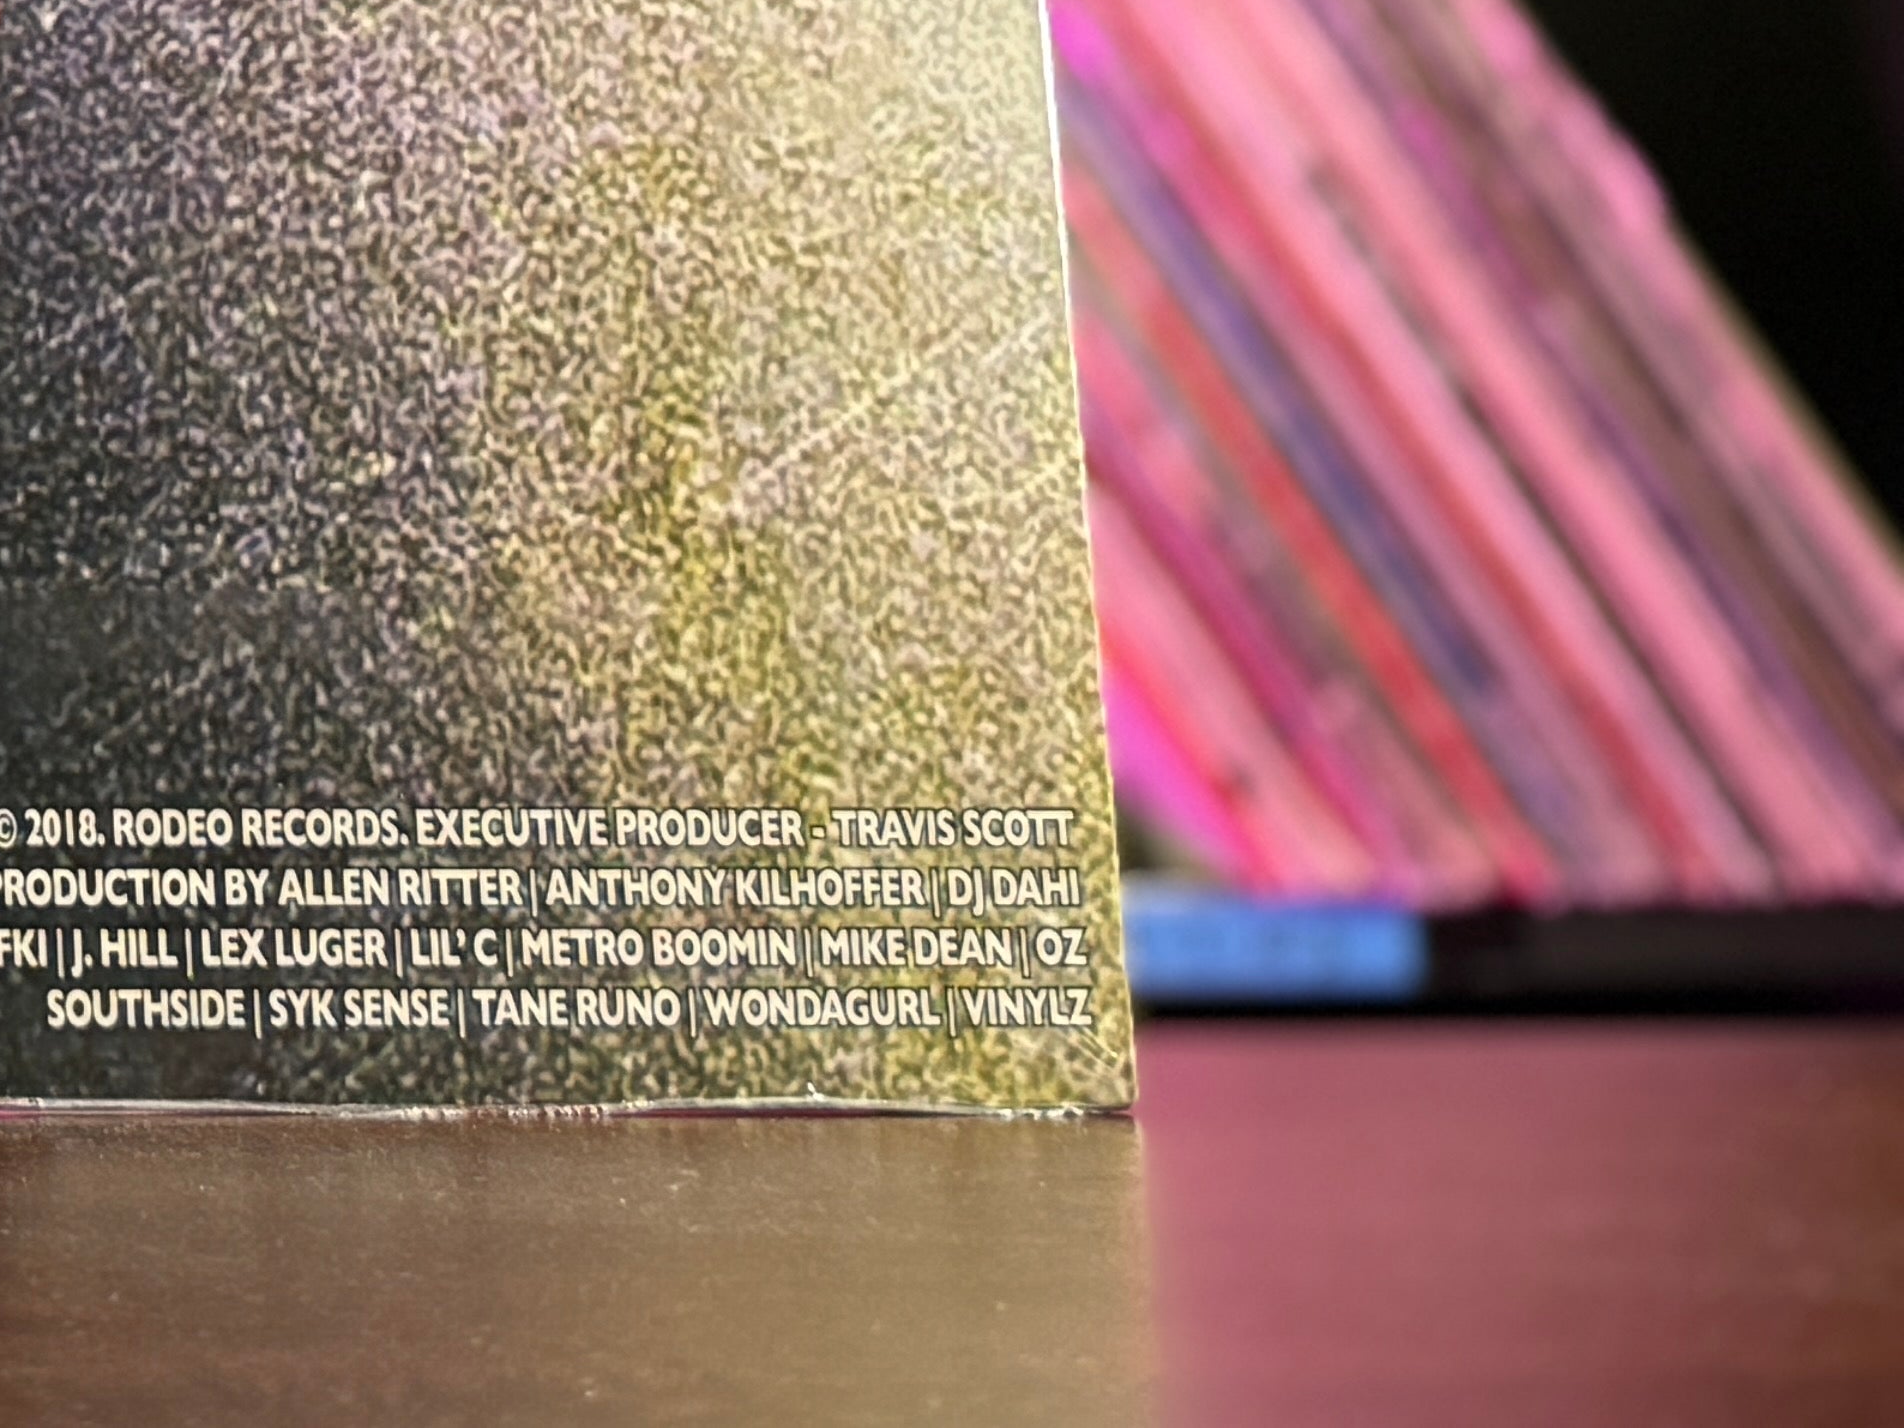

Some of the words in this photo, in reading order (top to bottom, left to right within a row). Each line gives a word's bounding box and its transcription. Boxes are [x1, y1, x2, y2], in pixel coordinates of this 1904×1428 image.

[24, 807, 106, 848] 2018.
[113, 807, 233, 848] RODEO
[241, 807, 408, 848] RECORDS.
[415, 807, 608, 847] EXECUTIVE
[616, 808, 805, 847] PRODUCER
[831, 809, 956, 847] TRAVIS
[963, 809, 1075, 847] SCOTT
[224, 868, 270, 907] BY
[277, 868, 389, 907] ALLEN
[399, 868, 524, 907] RITTER
[545, 868, 727, 907] ANTHONY
[736, 868, 927, 906] KILHOFFER
[948, 868, 984, 918] DJ
[992, 868, 1080, 906] DAHI
[70, 928, 93, 979] J.
[99, 928, 179, 968] HILL
[201, 928, 267, 968] LEX
[274, 928, 388, 968] LUGER
[473, 928, 498, 968] C
[521, 928, 644, 967] METRO
[652, 928, 796, 967] BOOMIN
[821, 928, 908, 967] MIKE
[913, 928, 1013, 967] DEAN
[1036, 928, 1088, 967] OZ
[47, 988, 246, 1029] SOUTHSIDE
[269, 988, 335, 1029] SYK
[343, 988, 451, 1028] SENSE
[472, 988, 572, 1028] TANE
[576, 988, 682, 1027] RUNO
[703, 988, 941, 1027] WONDAGURL
[963, 987, 1092, 1027] VINYLZ
